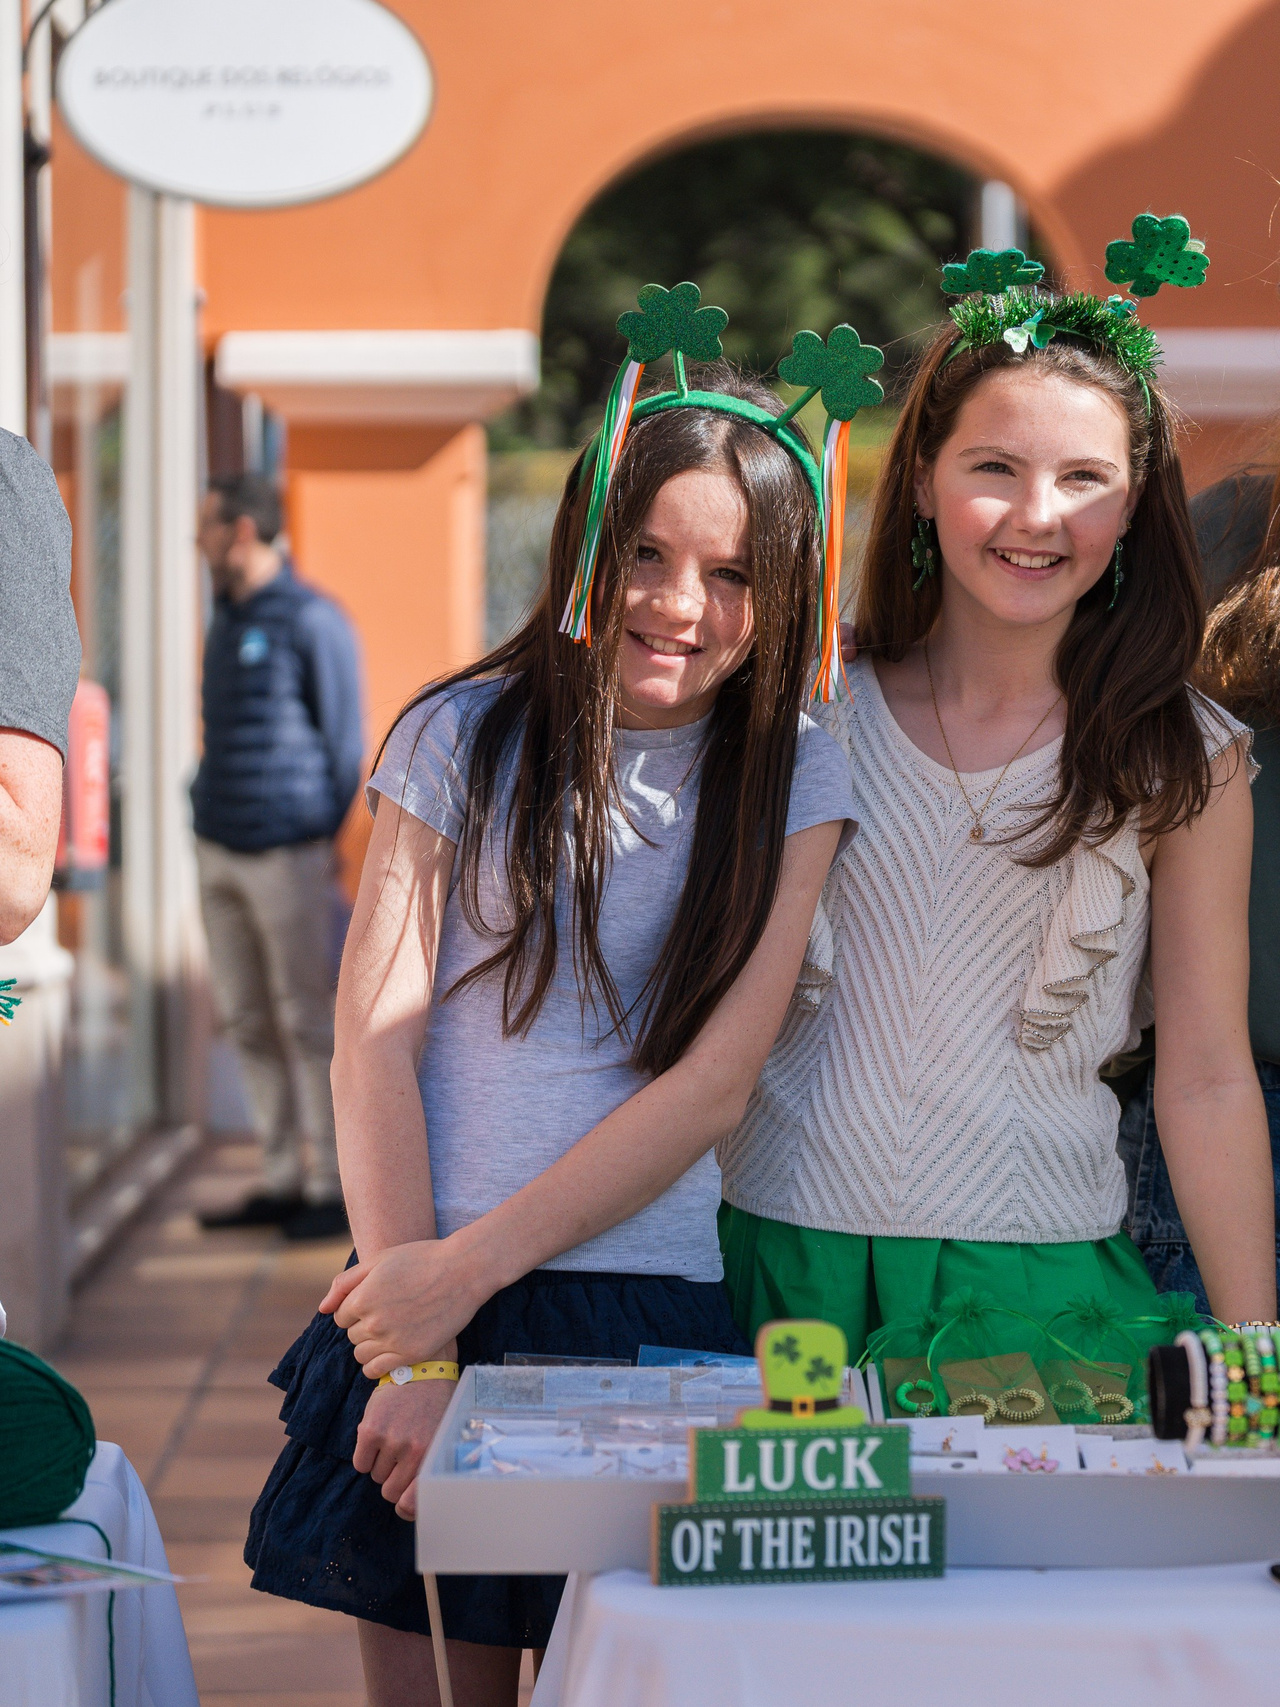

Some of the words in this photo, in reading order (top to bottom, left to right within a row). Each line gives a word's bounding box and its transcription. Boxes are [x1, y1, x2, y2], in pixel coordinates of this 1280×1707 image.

[722, 1436, 883, 1493] LUCK
[671, 1519, 726, 1573] OF
[732, 1517, 816, 1570] THE
[824, 1513, 932, 1568] IRISH
